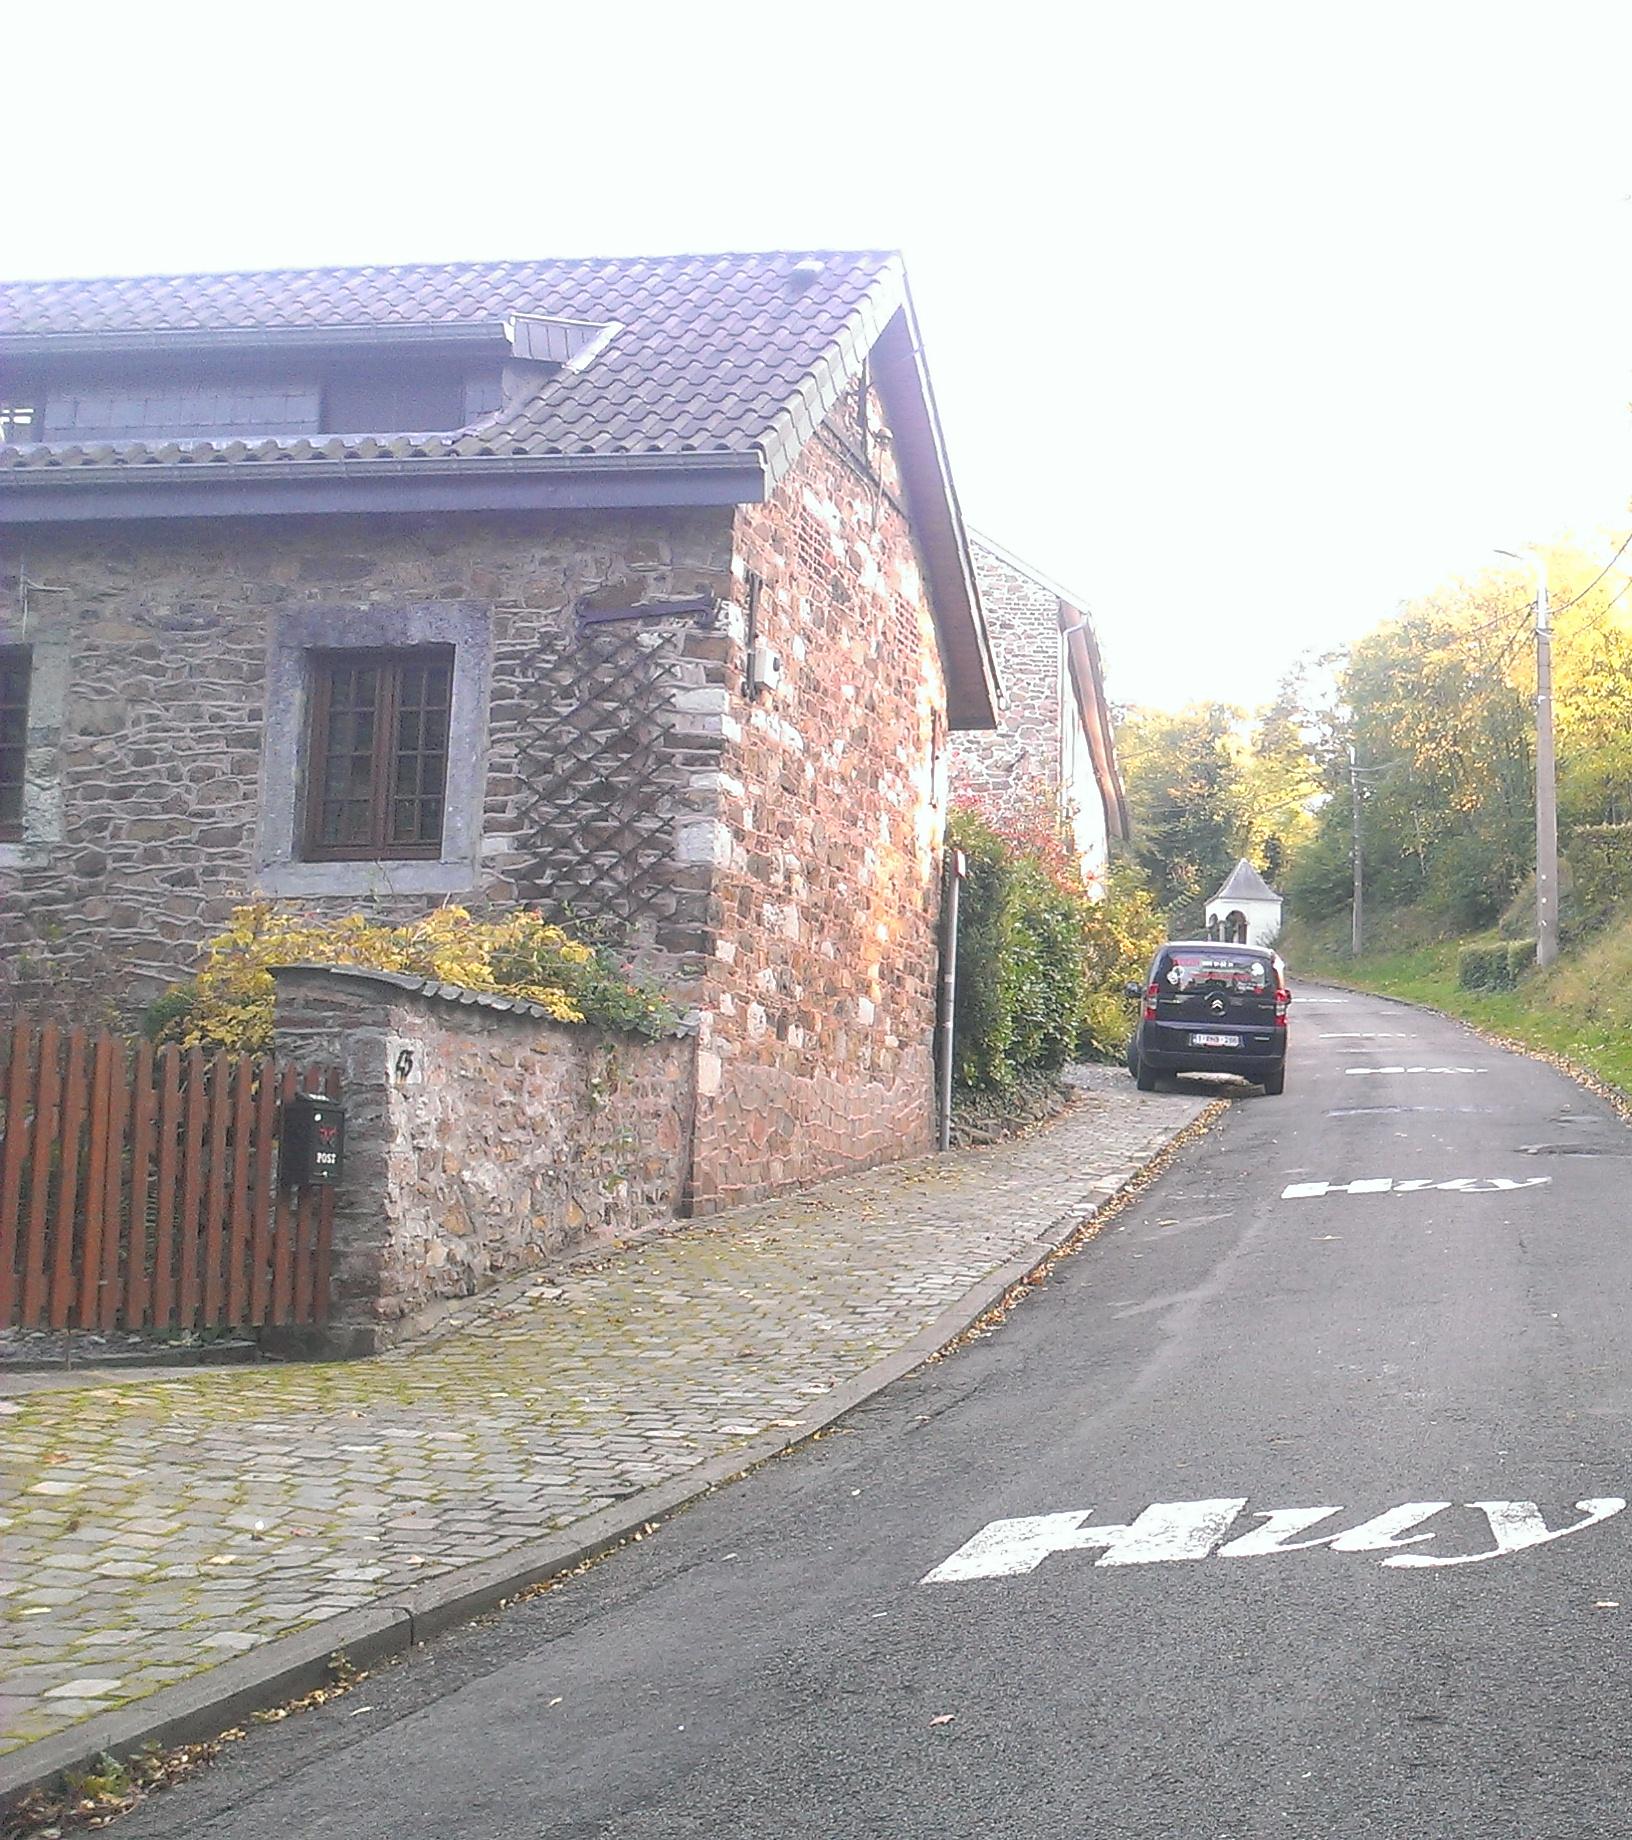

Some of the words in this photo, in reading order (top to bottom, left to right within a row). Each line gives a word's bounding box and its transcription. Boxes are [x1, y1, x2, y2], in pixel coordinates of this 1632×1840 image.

[316, 1152, 337, 1164] POST
[1281, 1177, 1554, 1199] Huy
[919, 1497, 1627, 1585] Huy
